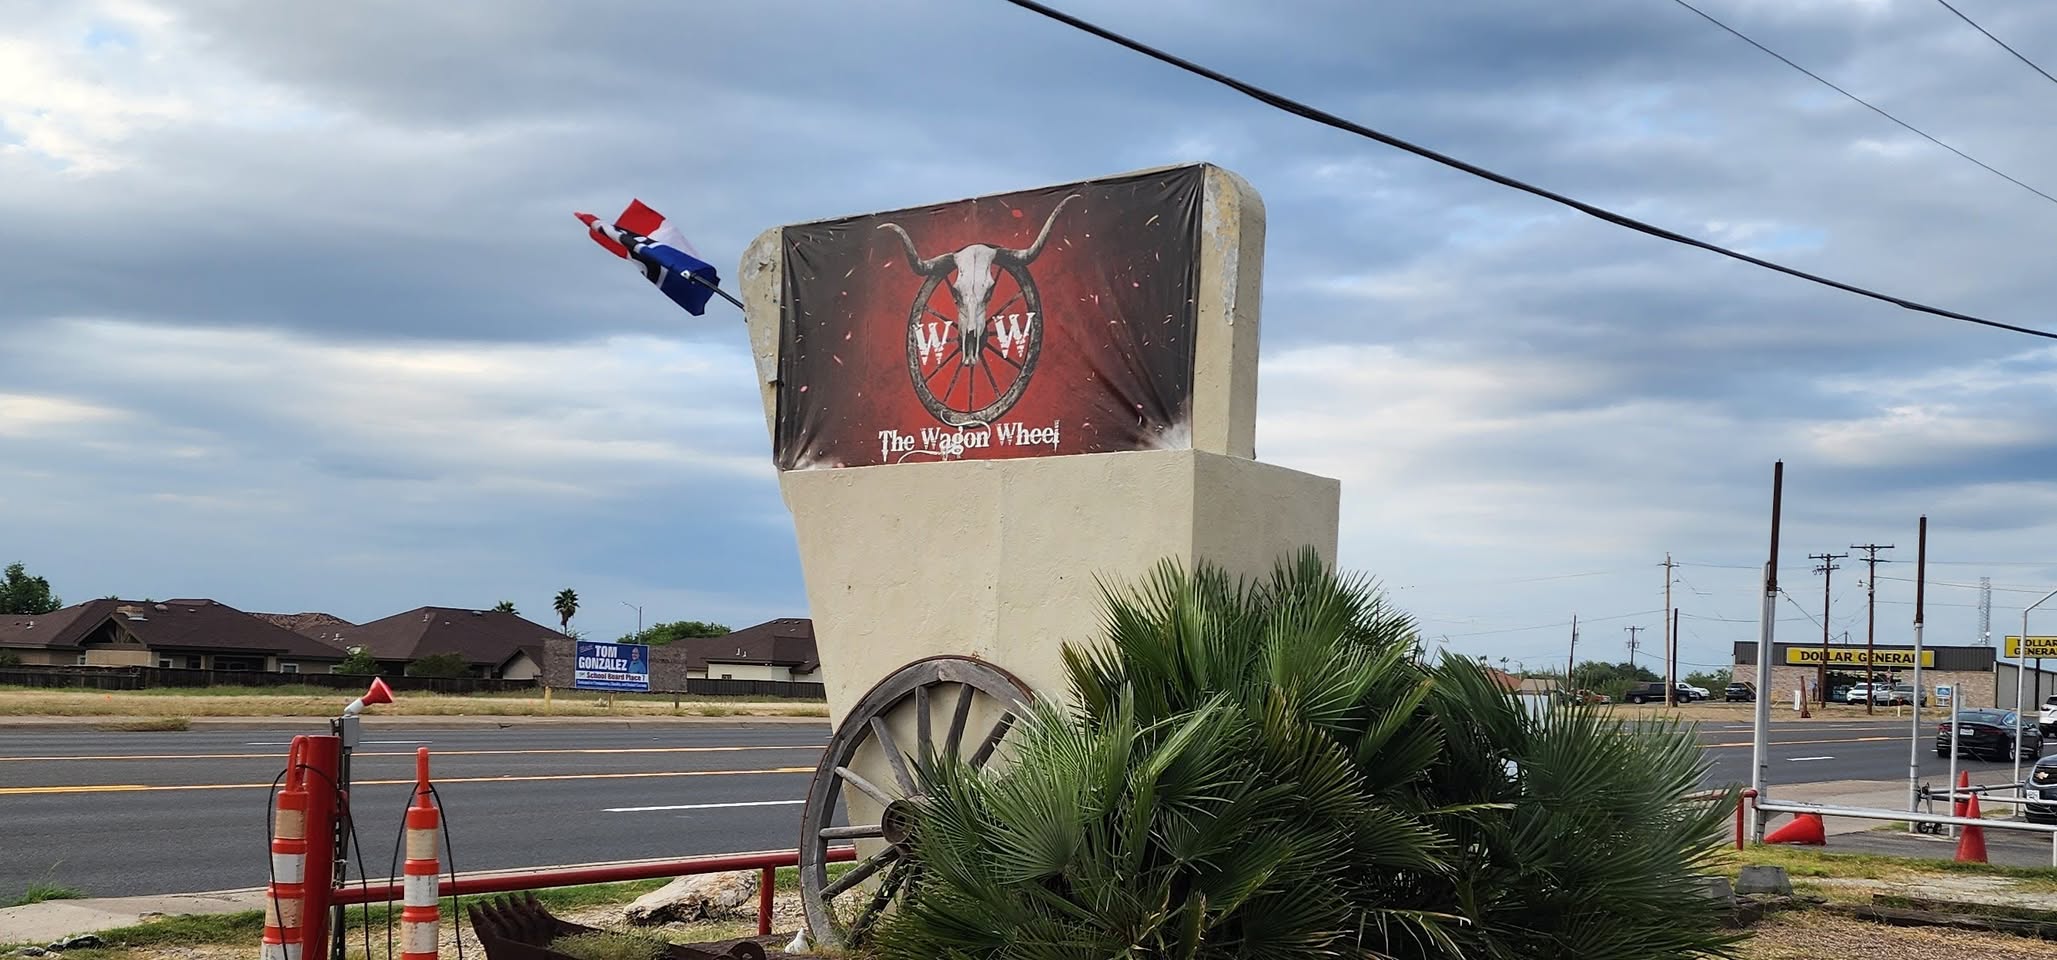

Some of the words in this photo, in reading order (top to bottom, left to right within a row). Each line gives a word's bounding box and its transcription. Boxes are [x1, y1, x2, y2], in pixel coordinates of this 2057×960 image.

[912, 320, 953, 365] W
[991, 312, 1036, 359] W
[878, 430, 915, 462] The
[921, 427, 989, 461] Wagon
[995, 420, 1060, 453] Wheel
[594, 645, 618, 658] TOM
[1801, 651, 1853, 662] DOLLAR
[578, 656, 628, 671] GONZALEZ
